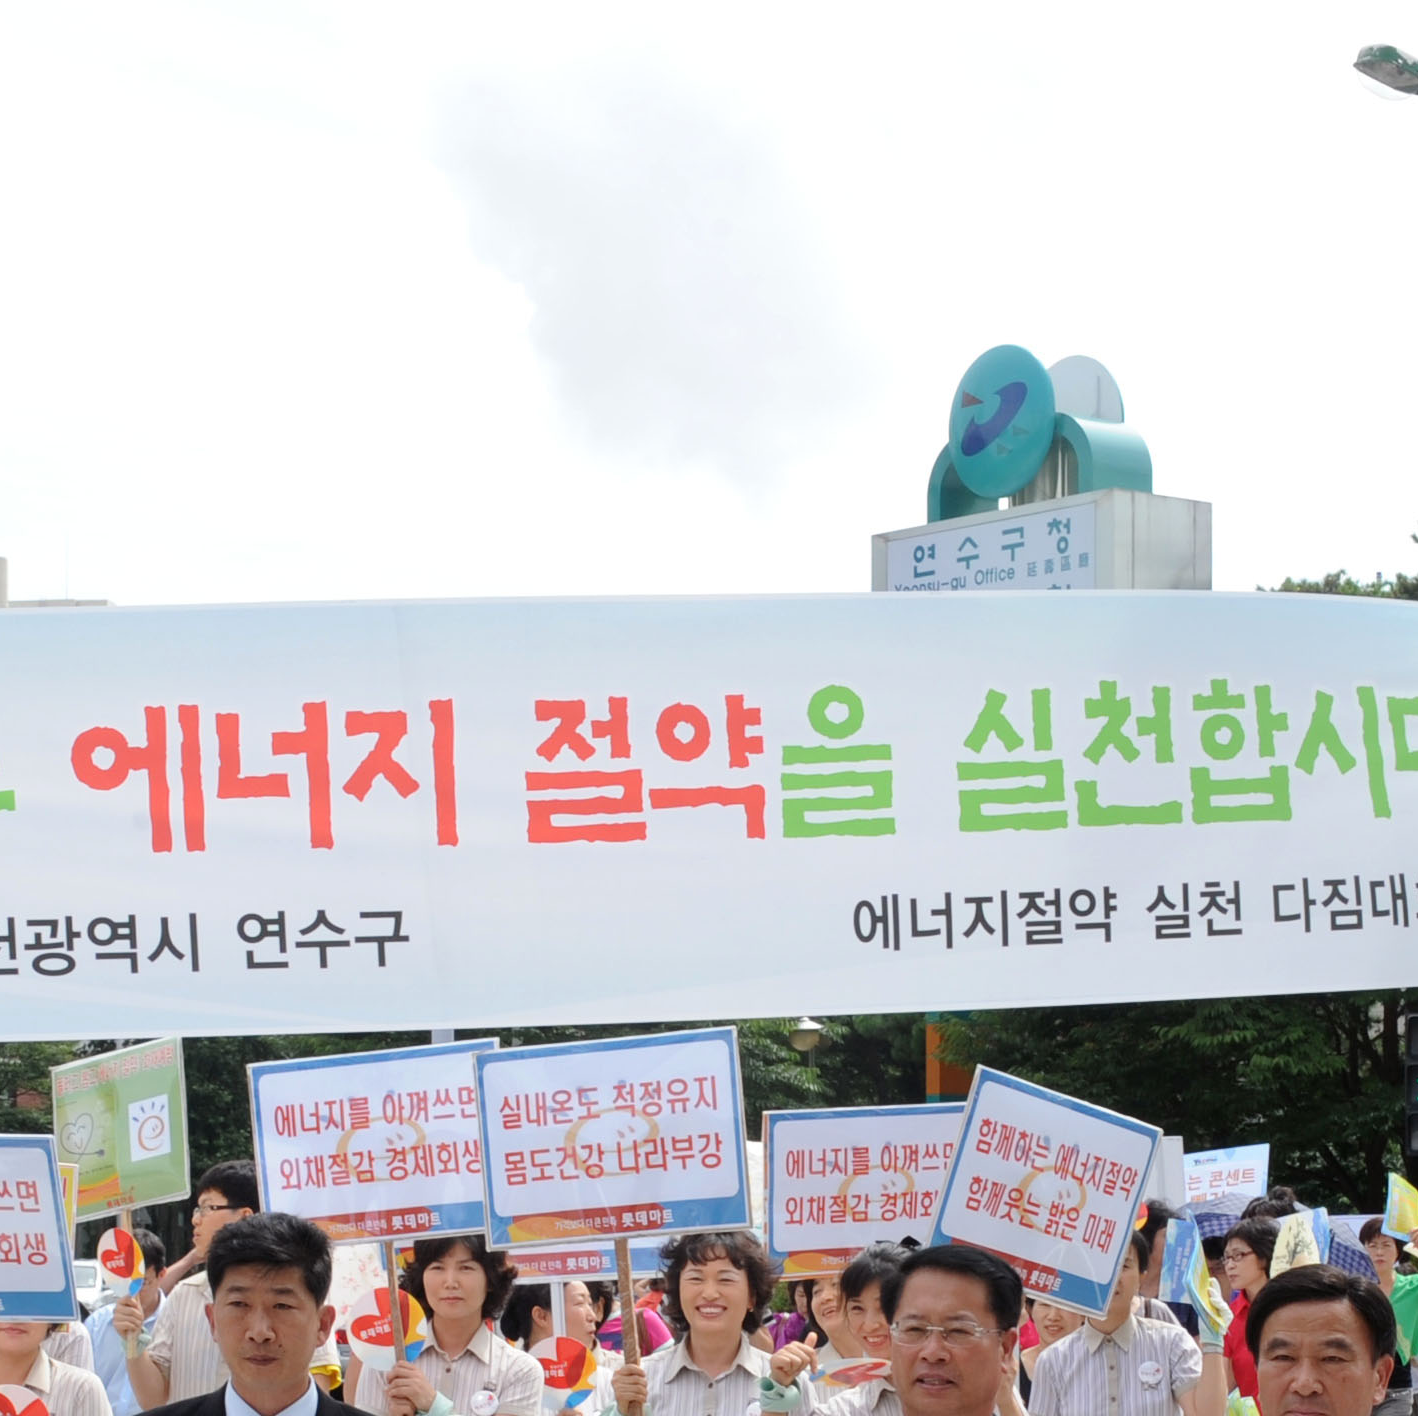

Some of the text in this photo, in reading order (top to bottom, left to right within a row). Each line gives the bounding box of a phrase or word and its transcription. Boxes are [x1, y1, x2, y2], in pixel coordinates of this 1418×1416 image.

[913, 517, 1071, 579] 연수구청
[974, 566, 1015, 585] Office
[70, 699, 459, 853] 에너지
[524, 684, 897, 843] 절약을
[236, 908, 410, 970] 연수구
[853, 884, 1118, 951] 에너지절약
[1146, 881, 1243, 940] 실천
[274, 1086, 477, 1138] 에너지를 아껴쓰면
[499, 1075, 718, 1130] 실내온도 적정유지
[280, 1149, 376, 1191] 외채절감
[504, 1132, 723, 1186] 몸도건강 나라부강
[785, 1146, 870, 1179] 에너지를
[976, 1117, 1138, 1202] 함께하는 에너지절약
[1208, 1168, 1256, 1189] 콘센트
[391, 1211, 442, 1231] 롯데마트
[621, 1208, 674, 1228] 롯데마트
[784, 1193, 871, 1225] 외채절감
[966, 1175, 1117, 1254] 함께웃는 밝은 미래
[566, 1256, 612, 1270] 롯데마트
